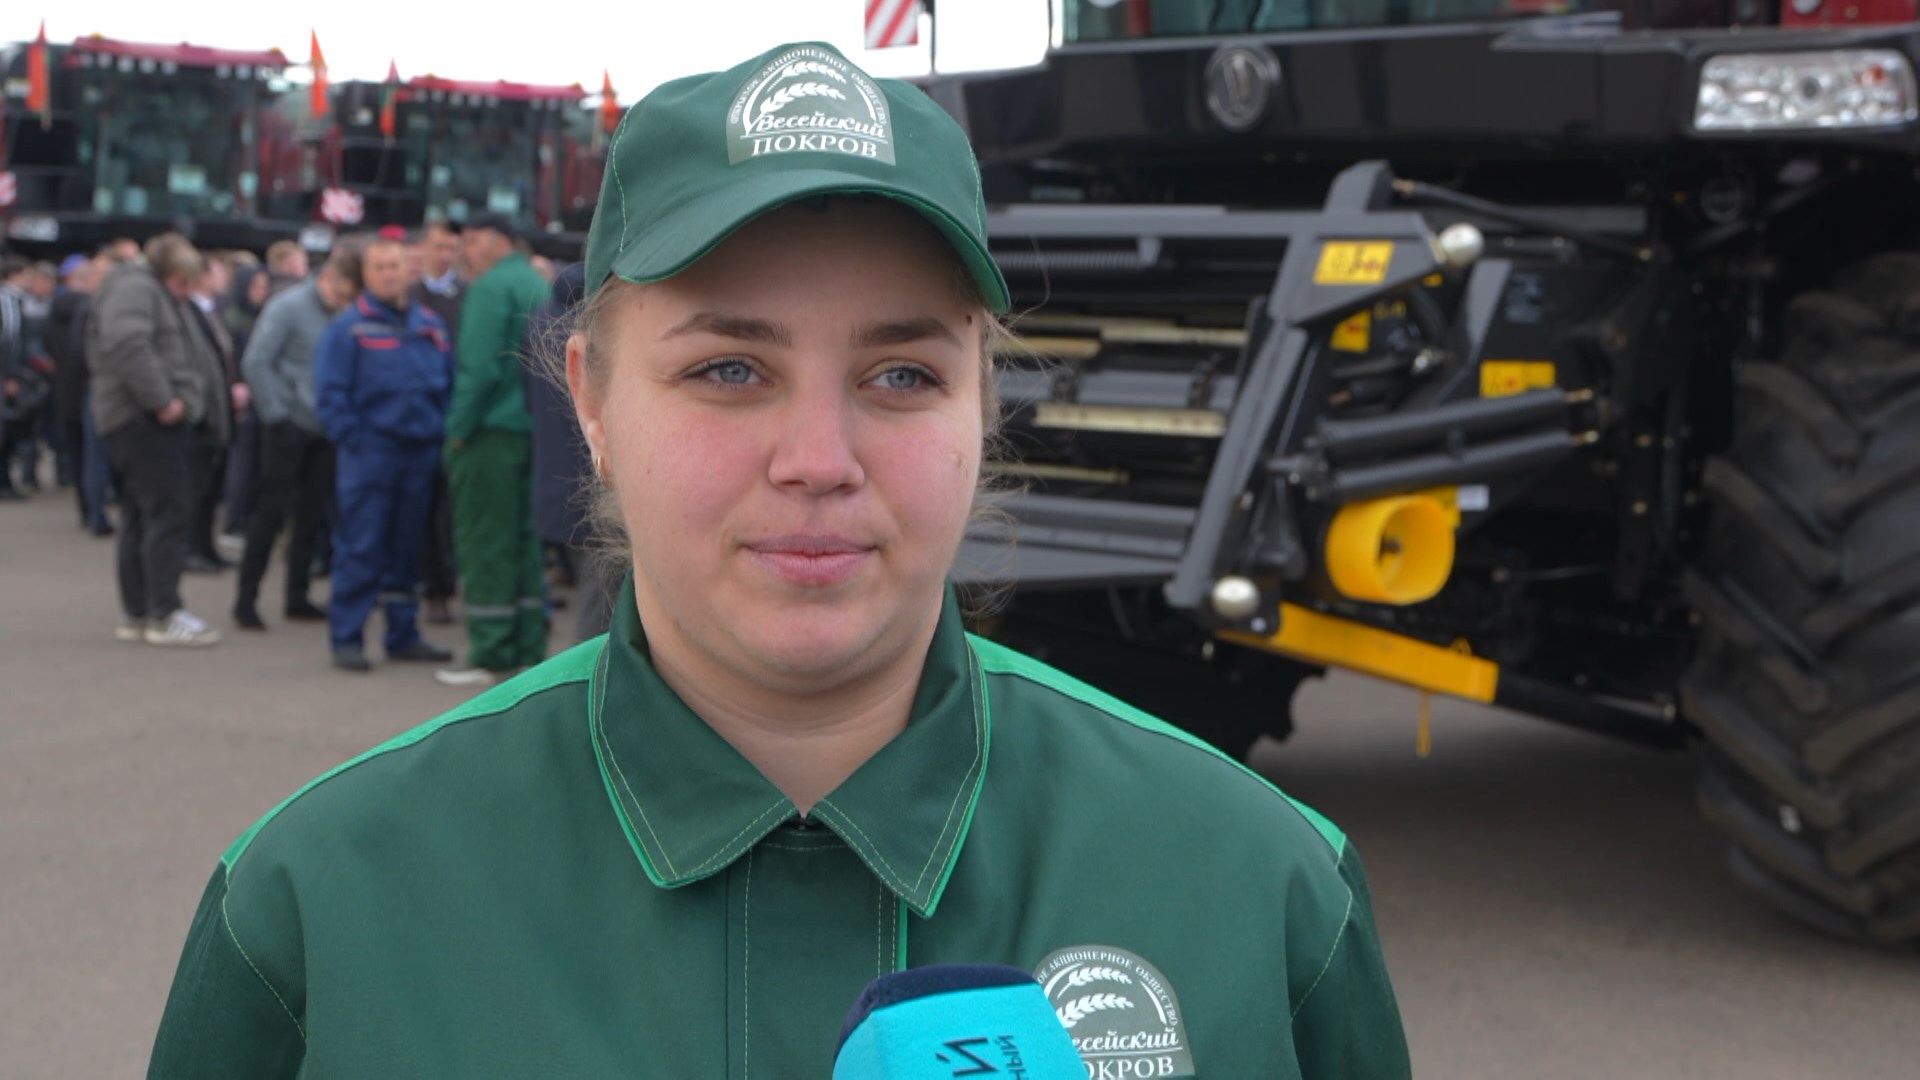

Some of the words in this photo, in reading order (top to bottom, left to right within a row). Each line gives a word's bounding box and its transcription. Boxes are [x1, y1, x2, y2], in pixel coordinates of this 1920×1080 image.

[756, 111, 886, 139] Весейский
[752, 134, 878, 158] ПОКРОВ
[1049, 950, 1134, 974] АКЦИОНЕРНОЕ
[1135, 965, 1178, 1027] ОБЩЕСТВО
[1071, 1027, 1180, 1051] есейский
